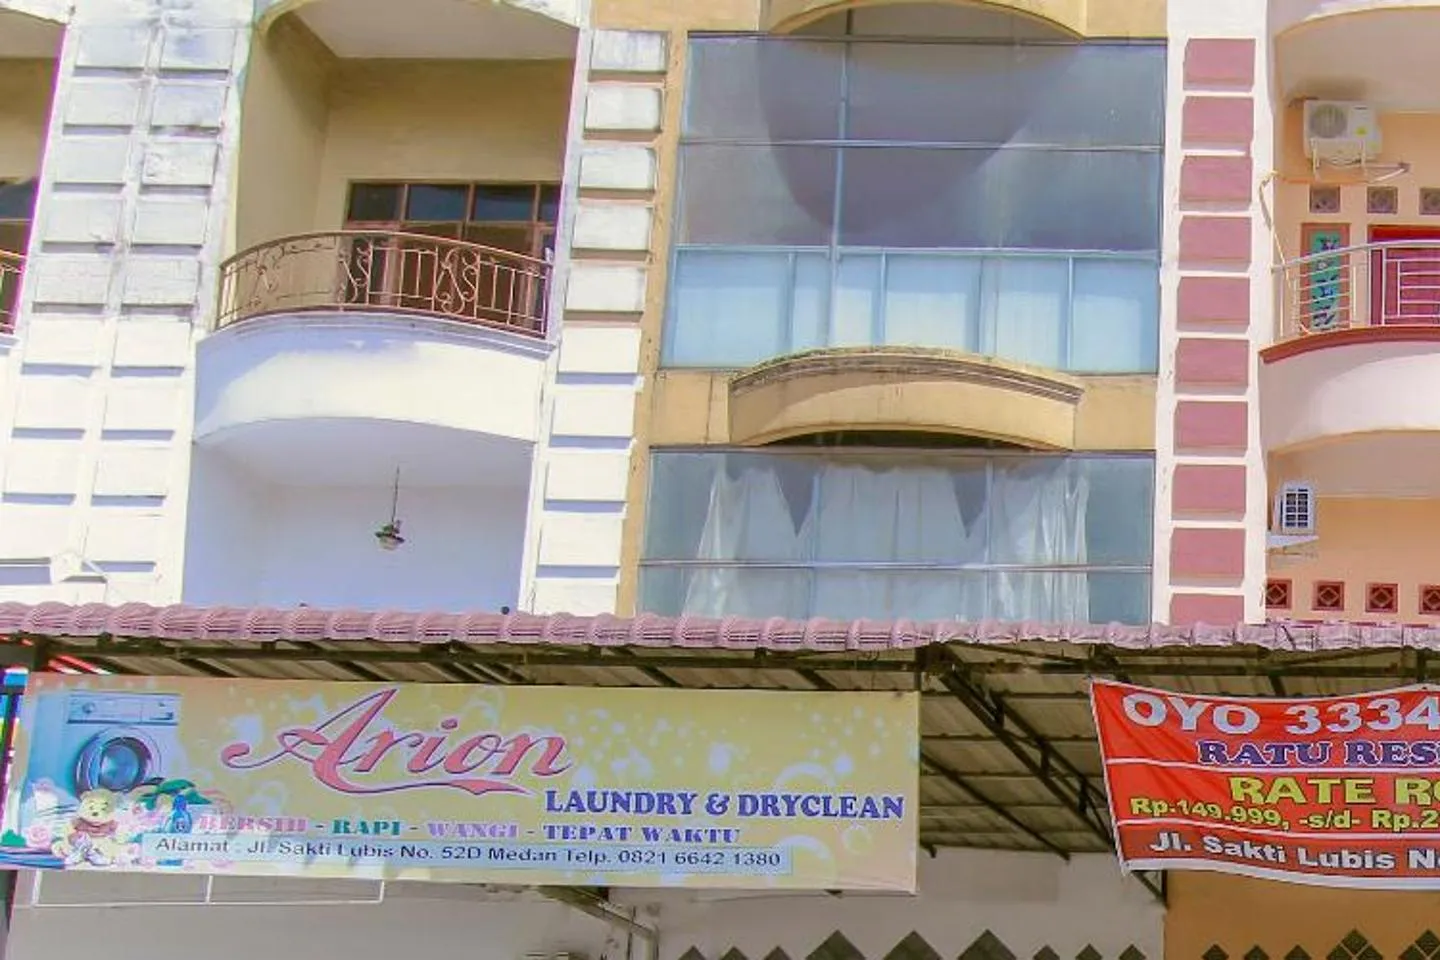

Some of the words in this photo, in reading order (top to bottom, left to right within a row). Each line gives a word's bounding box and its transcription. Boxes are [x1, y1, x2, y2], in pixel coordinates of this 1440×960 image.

[1122, 694, 1260, 735] OYO
[220, 688, 573, 796] Arion
[1196, 740, 1333, 767] RATU
[544, 790, 695, 816] LAUNDRY
[704, 795, 730, 815] &
[737, 794, 905, 820] DRYCLEAN
[1228, 776, 1377, 805] RATE
[199, 815, 309, 833] BERSIH
[332, 819, 400, 836] RAPI
[426, 821, 518, 840] WANGI
[543, 824, 631, 841] TEPAT
[642, 826, 741, 844] WAKTU
[155, 837, 229, 853] Alamat
[279, 841, 330, 856] Sakti
[337, 842, 394, 858] Lubis
[400, 843, 433, 859] No.
[442, 845, 482, 861] 52D
[487, 846, 557, 862] Medan
[563, 848, 610, 865] Telp.
[618, 849, 667, 865] 0821
[674, 850, 724, 866] 6642
[732, 851, 781, 867] 1380
[1149, 832, 1192, 852] Jl.
[1203, 836, 1287, 864] Sakti
[1298, 847, 1396, 869] Lubis
